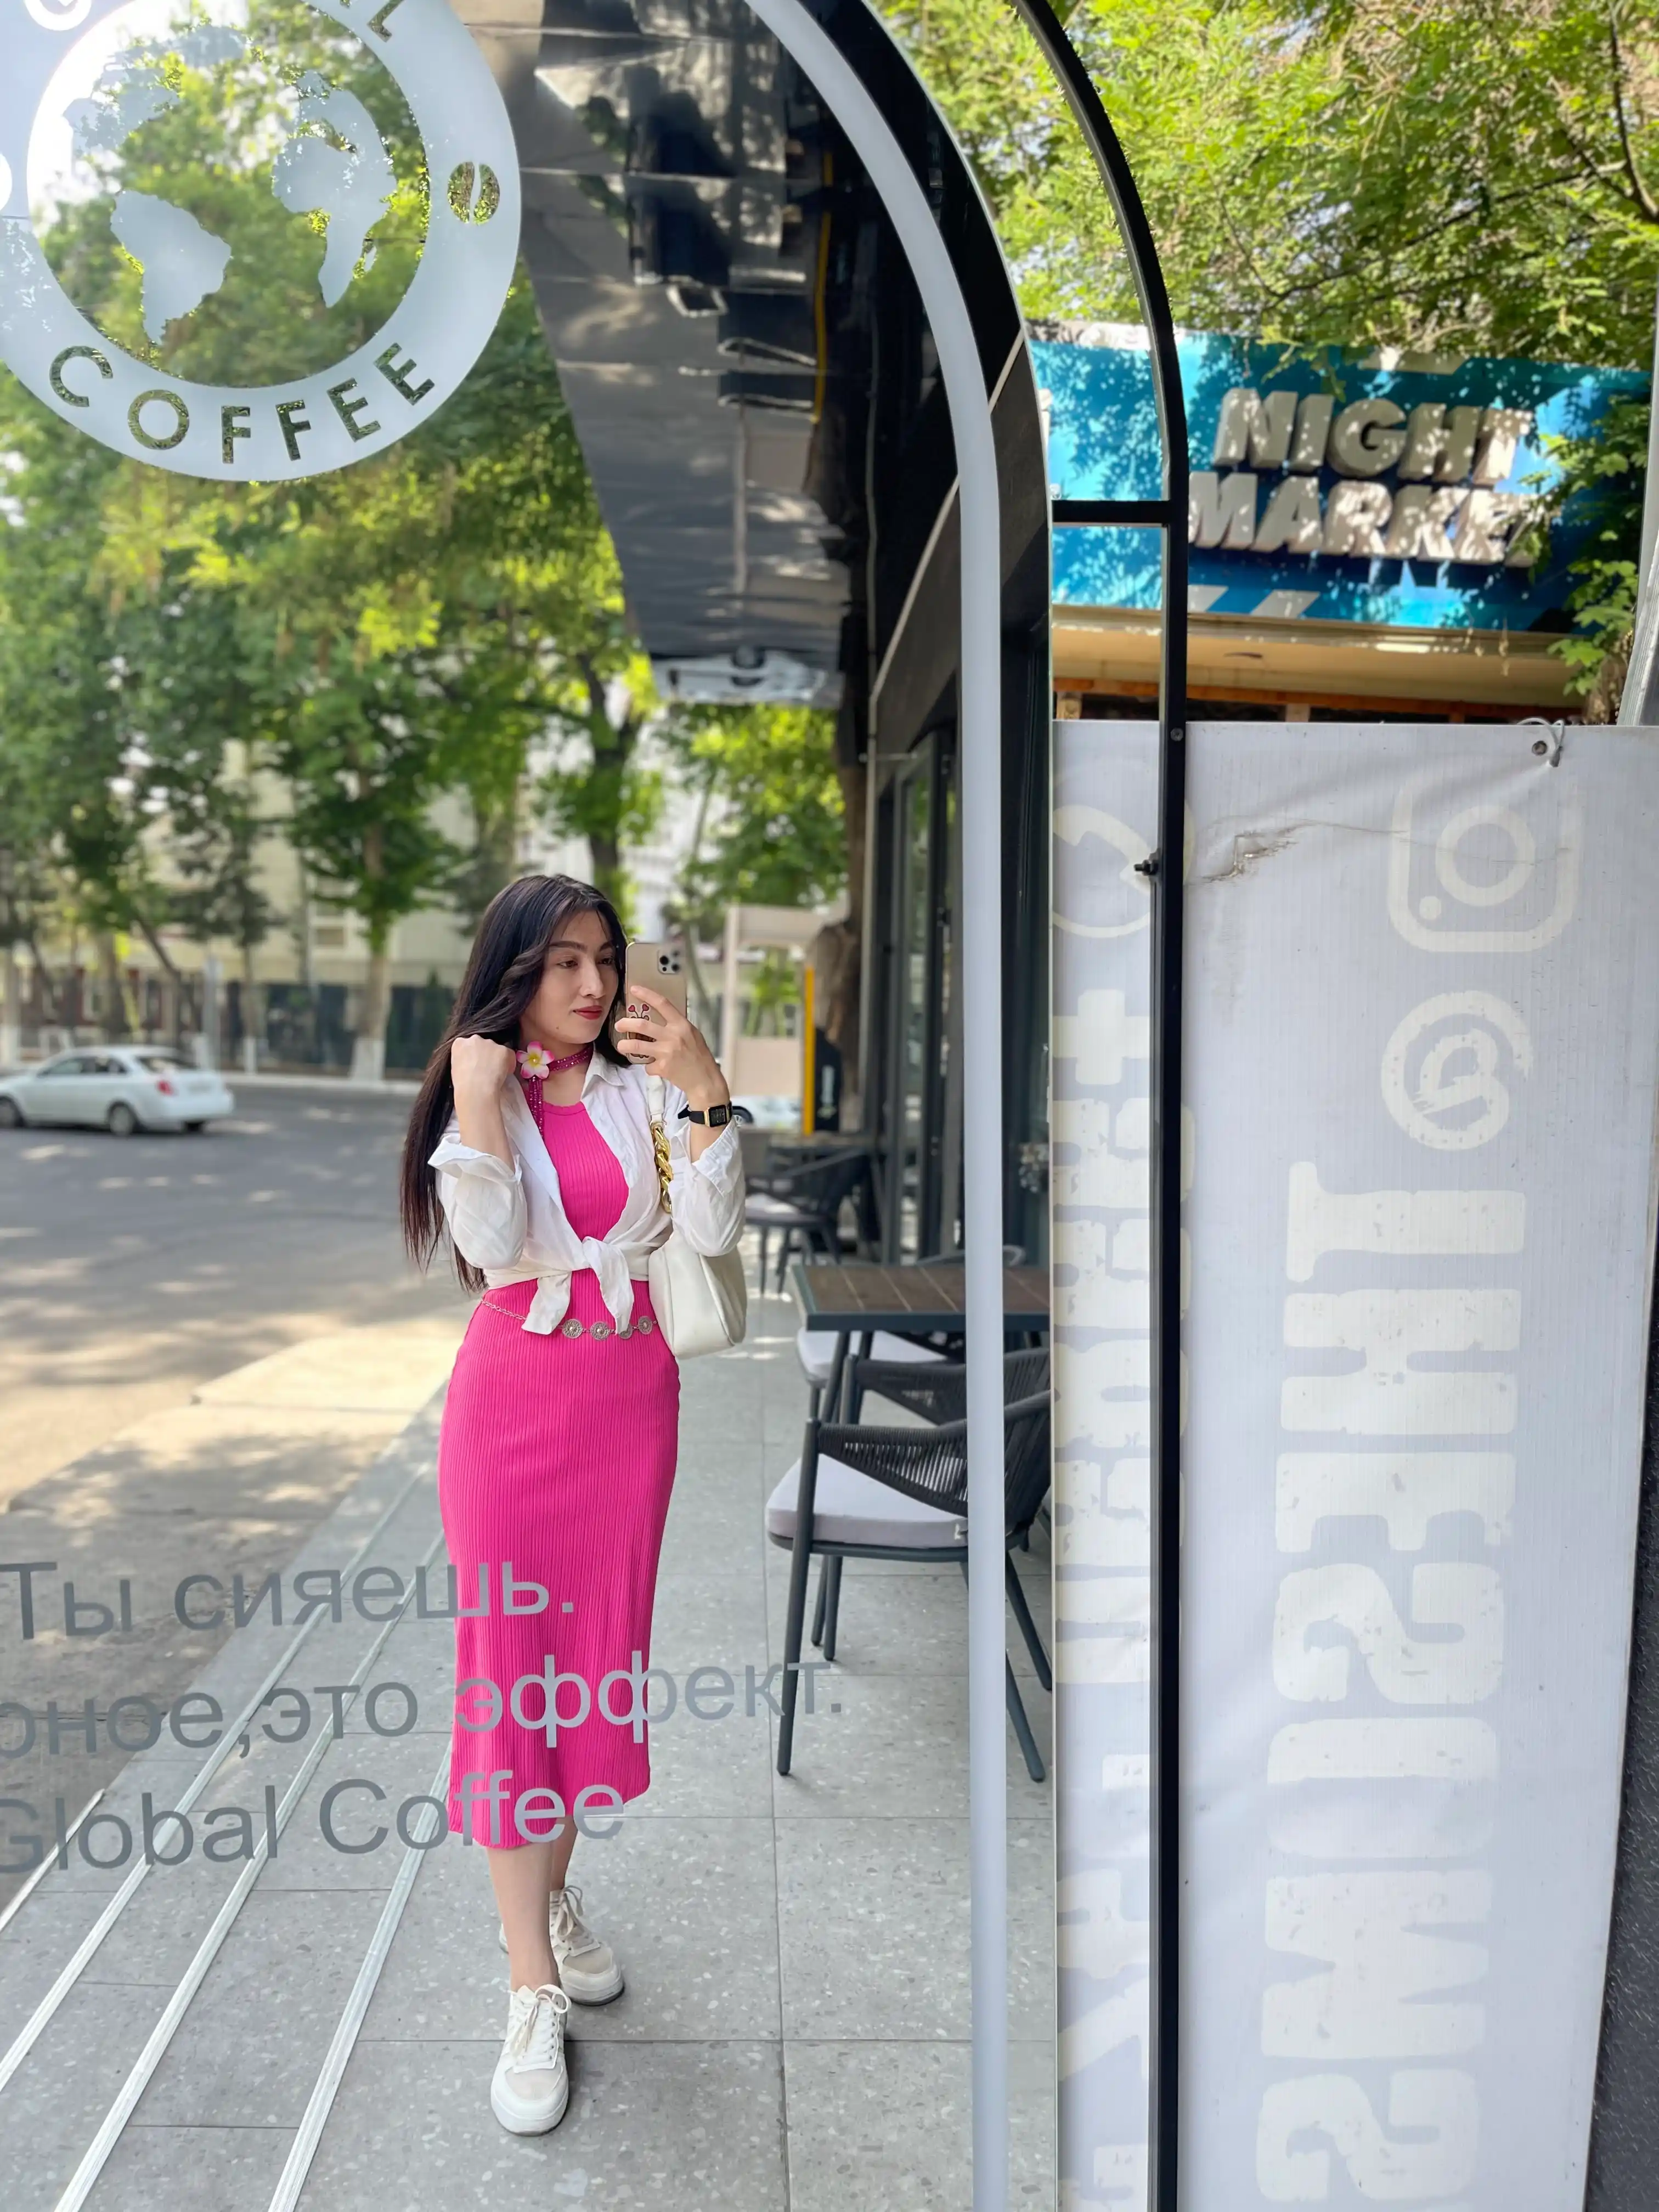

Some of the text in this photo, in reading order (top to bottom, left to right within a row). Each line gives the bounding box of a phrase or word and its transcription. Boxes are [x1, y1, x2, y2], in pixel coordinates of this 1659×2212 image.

[49, 342, 435, 464] COFFEE
[1213, 387, 1534, 485] NIGHT
[0, 1561, 573, 1640] Ты сияешь.
[455, 1650, 841, 1748] эффект.
[0, 1770, 624, 1874] Global Coffee
